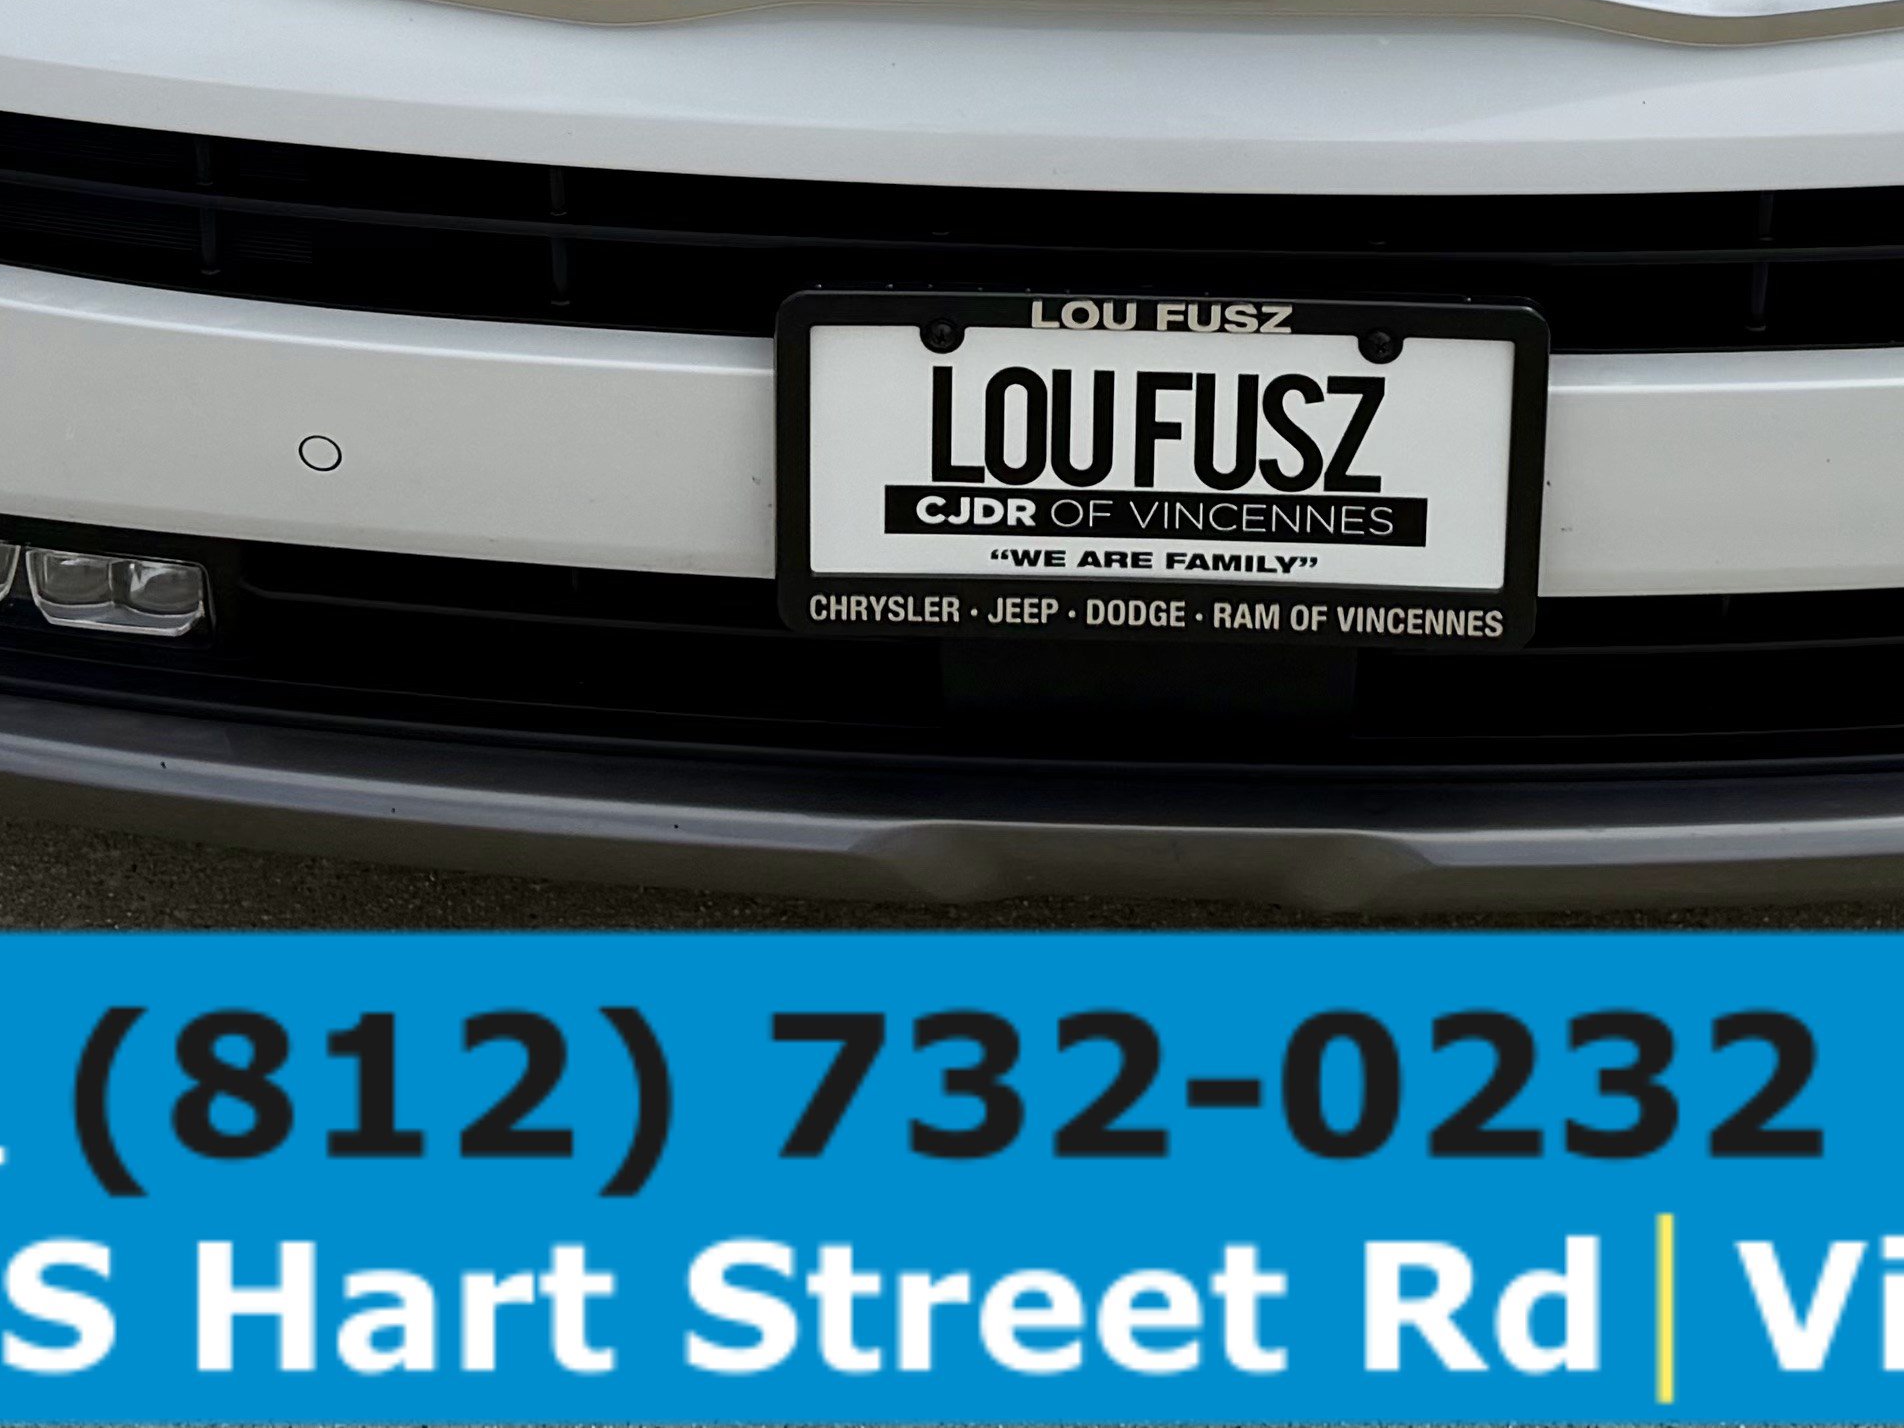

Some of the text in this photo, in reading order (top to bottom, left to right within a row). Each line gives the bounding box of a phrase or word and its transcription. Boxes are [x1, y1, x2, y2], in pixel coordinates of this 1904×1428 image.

[1030, 298, 1294, 335] LOU FUSZ
[931, 365, 1387, 494] LOU FUSZ
[915, 495, 1395, 537] CJDR OF VINCENNES
[1076, 550, 1154, 570] ARE
[809, 593, 1504, 639] CHRYSLER JEEP DODGE RAM OF VINCENNES
